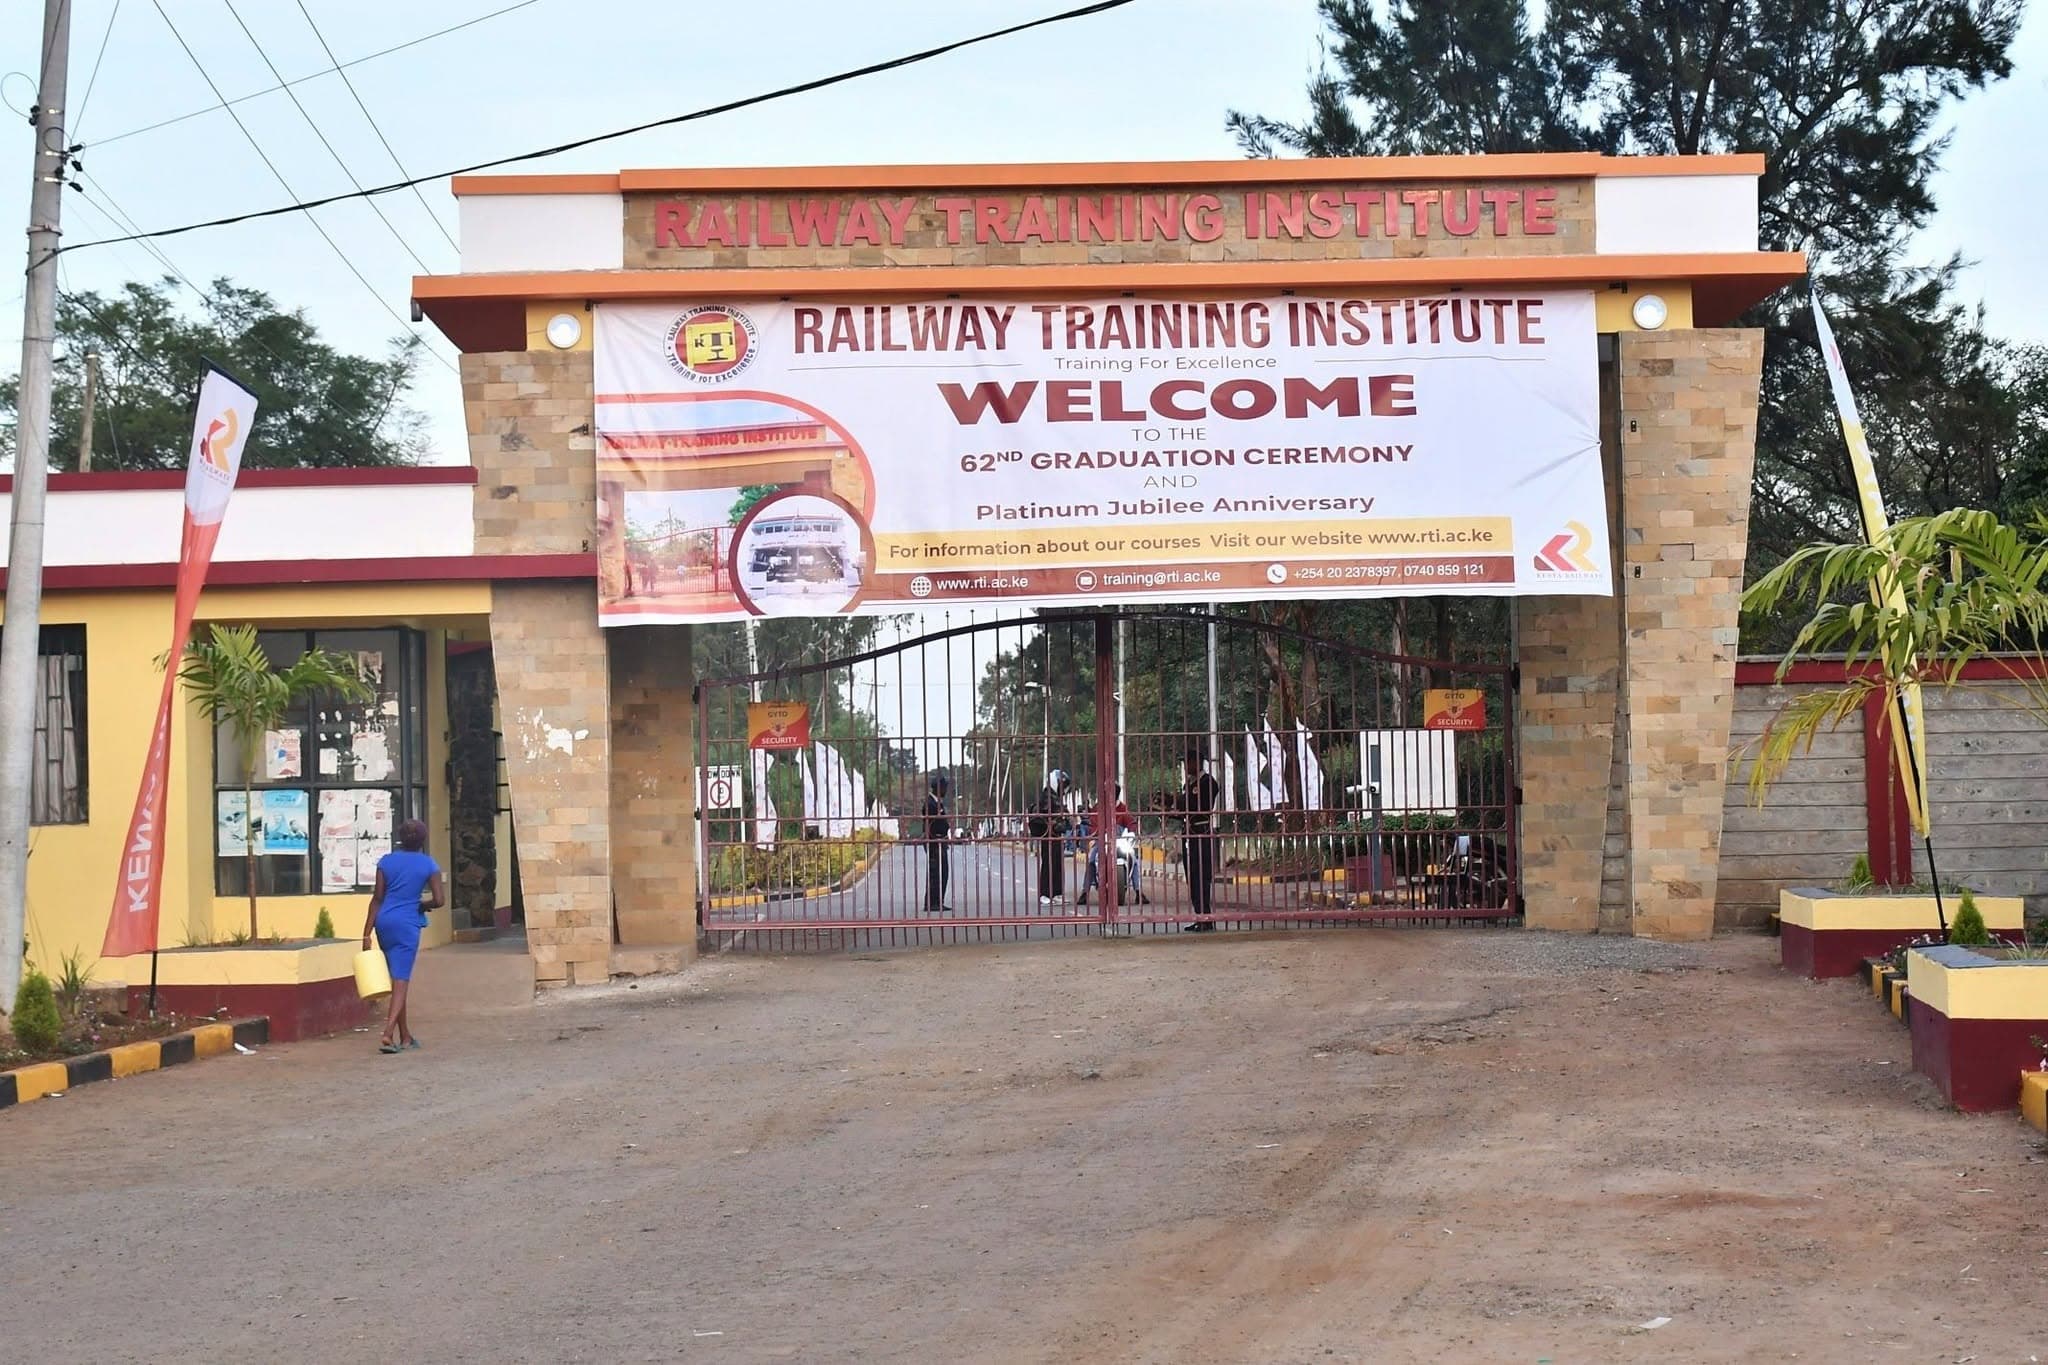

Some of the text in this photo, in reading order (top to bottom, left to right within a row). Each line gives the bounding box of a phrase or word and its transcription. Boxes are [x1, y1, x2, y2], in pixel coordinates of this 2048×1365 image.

[655, 188, 1559, 248] RAILWAY TRAINING INSTITUTE
[667, 305, 756, 341] RAILWAY TRAINING INSTITUTE
[794, 298, 1545, 353] RAILWAY TRAINING INSTITUTE
[666, 353, 697, 381] Training
[715, 348, 756, 383] Excellence
[1054, 355, 1277, 372] Training For Excellence
[936, 375, 1417, 425] WELCOME
[1131, 427, 1206, 441] TO THE
[961, 444, 1414, 473] 62ND GRADUATION CEREMONY
[1143, 475, 1198, 489] AND
[976, 495, 1375, 520] Platinum Jubilee Anniversary
[890, 529, 1493, 558] For information about our courses Visit our website www.rti.ac.ke
[1103, 570, 1221, 587] training@rti.ac.ke
[1293, 563, 1485, 580] +254 20 2378397, 0740 859 121
[936, 575, 1029, 591] www.rti.ac.ke
[1437, 718, 1473, 726] SECURITY
[761, 736, 798, 745] SECURITY
